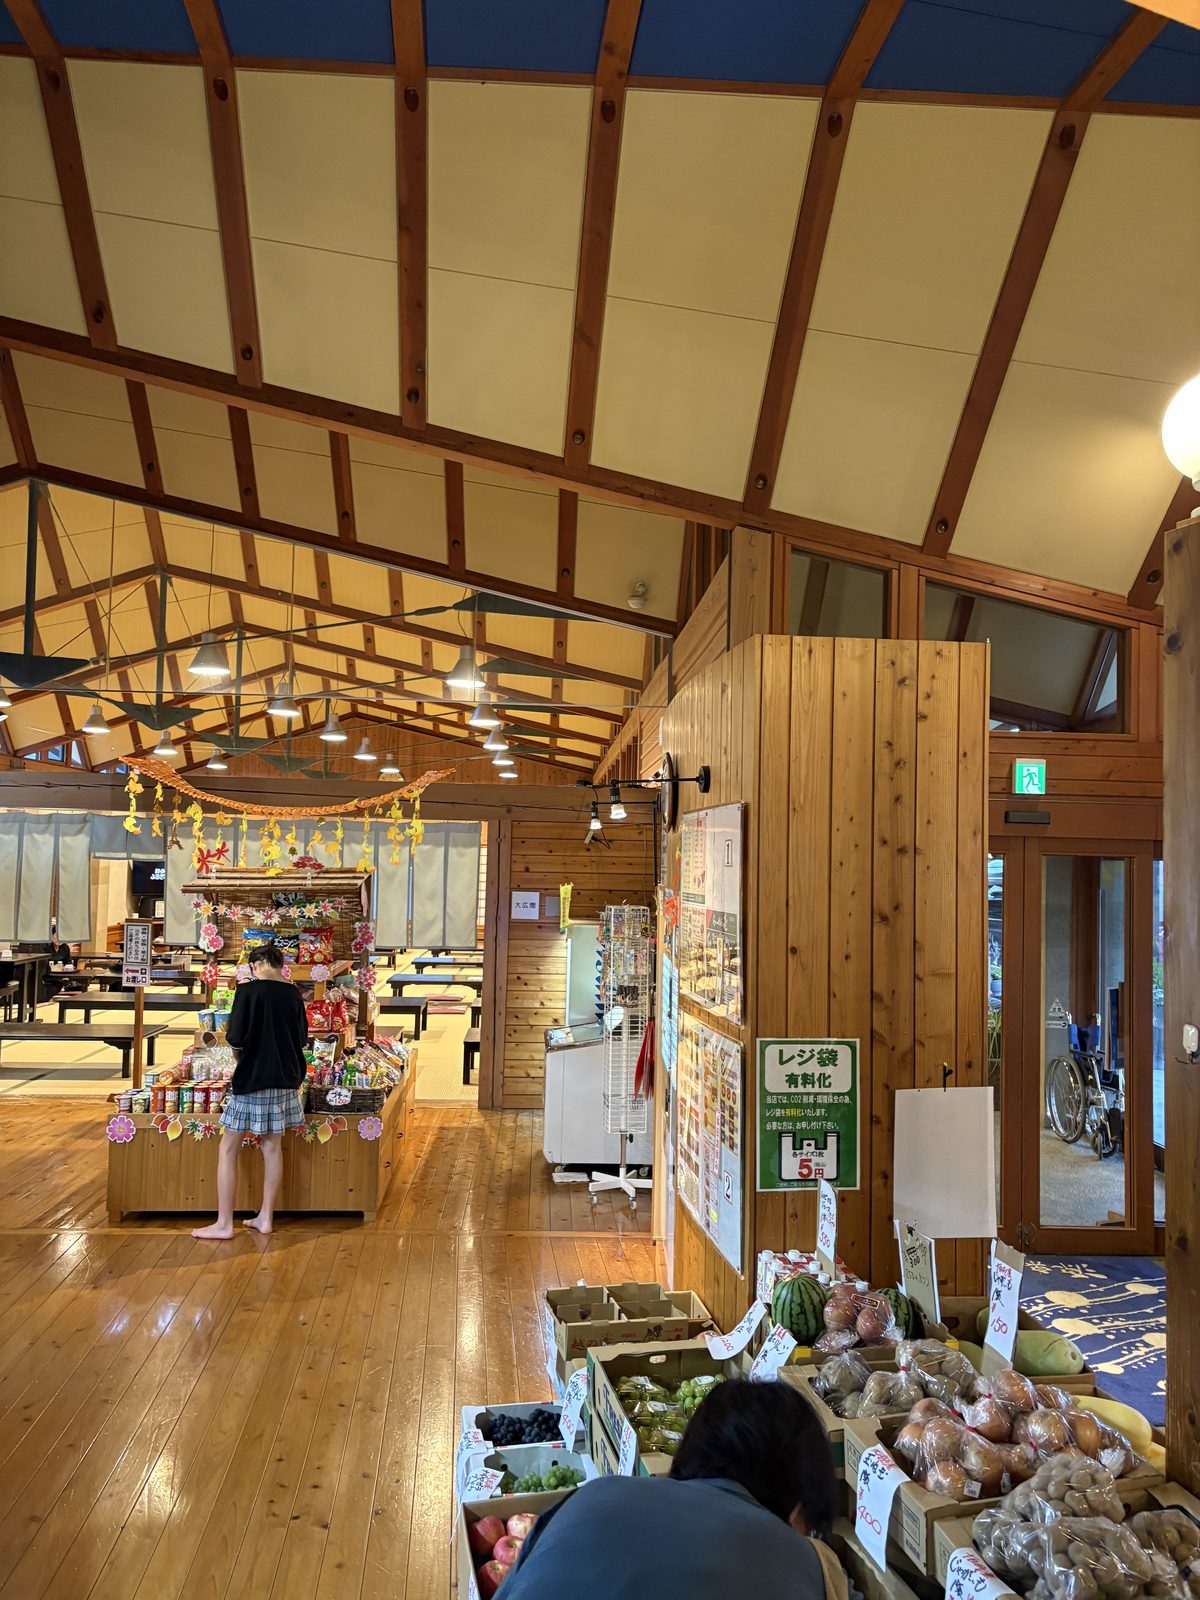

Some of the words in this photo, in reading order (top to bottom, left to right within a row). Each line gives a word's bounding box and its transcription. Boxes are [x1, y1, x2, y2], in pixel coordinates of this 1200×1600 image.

[778, 1048, 839, 1067] レジ袋
[785, 1072, 832, 1089] 有料化
[991, 1316, 1008, 1334] 150
[857, 1505, 882, 1535] 400
[949, 1555, 988, 1593] じゃがいも
